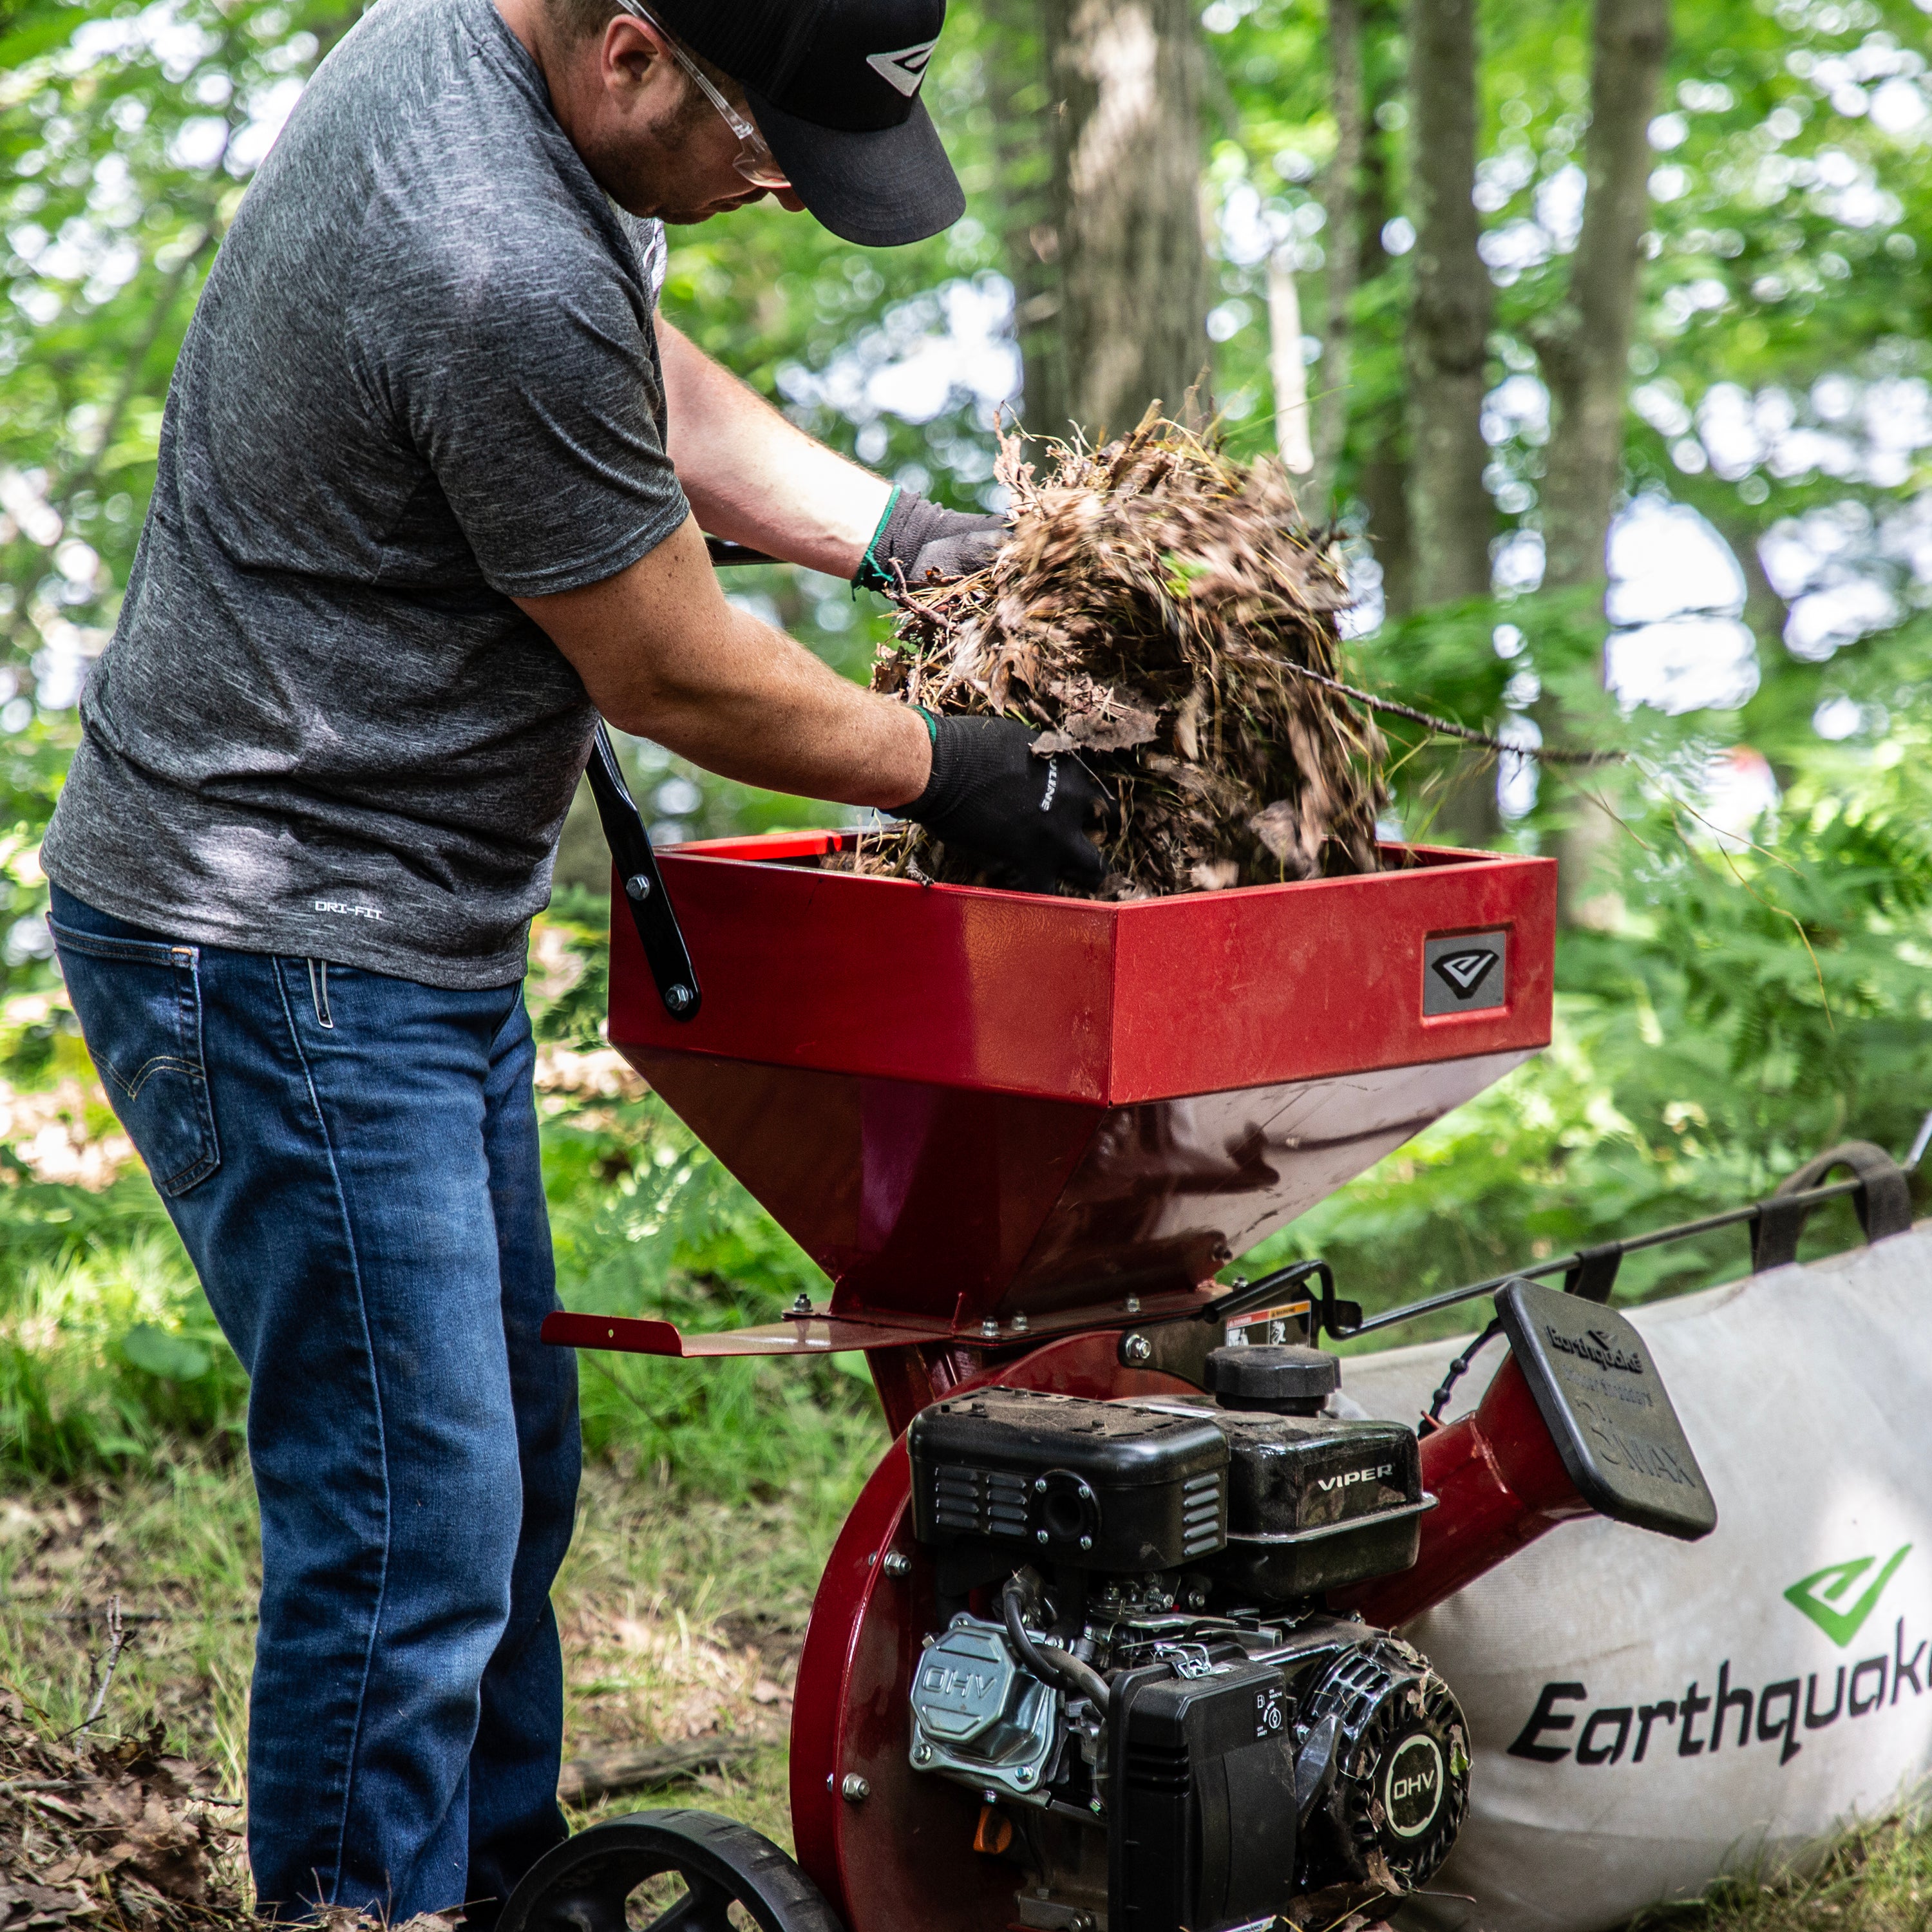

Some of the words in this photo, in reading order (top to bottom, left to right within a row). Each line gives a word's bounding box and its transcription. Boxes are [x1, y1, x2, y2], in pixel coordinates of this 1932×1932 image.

[314, 900, 383, 920] DRI-FIT
[1546, 1325, 1643, 1374] Earthquake
[1318, 1463, 1394, 1492] VIPER
[923, 1665, 998, 1699] OHV
[1506, 1615, 1932, 1766] Earthquak
[1394, 1770, 1435, 1801] OHV
